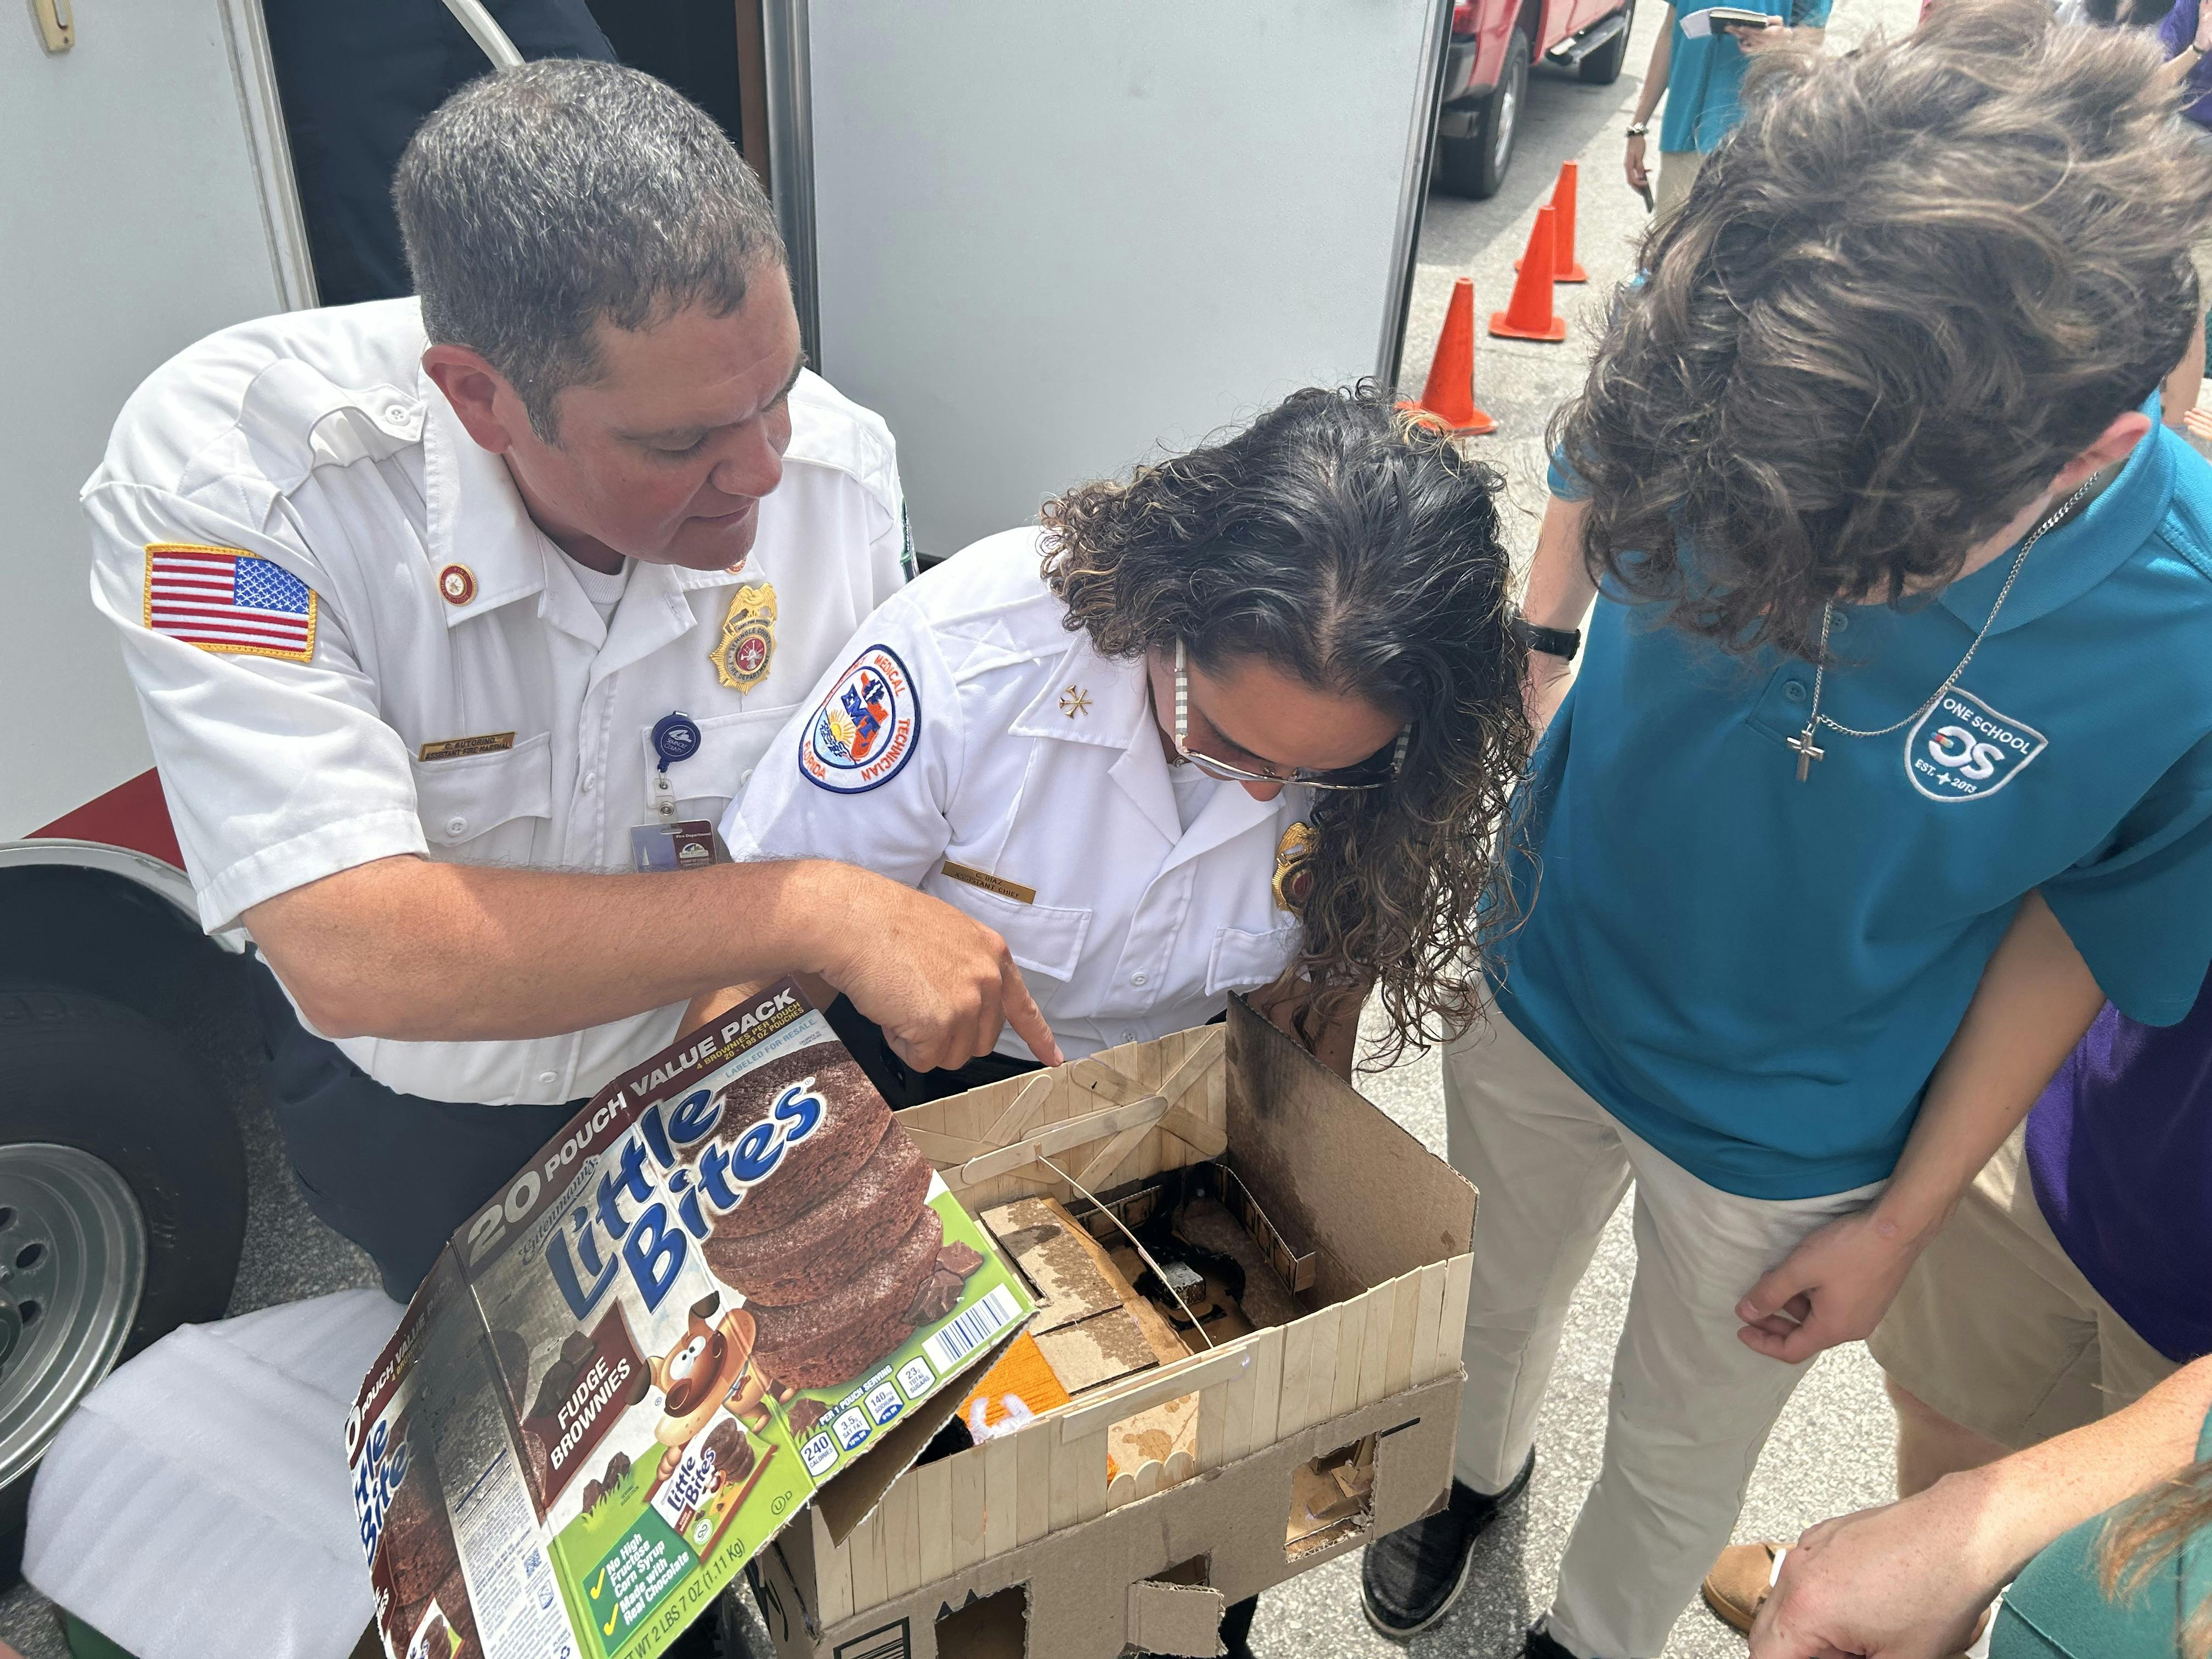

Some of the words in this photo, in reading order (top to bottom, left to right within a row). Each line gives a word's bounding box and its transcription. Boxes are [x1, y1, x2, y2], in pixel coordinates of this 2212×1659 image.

[731, 628, 755, 651] SEMINOLE
[757, 628, 771, 644] COUNTY
[728, 662, 739, 676] FIRE
[738, 657, 769, 681] DEPARTMENT
[874, 654, 906, 697] MEDICAL
[841, 684, 881, 739] EMT
[1943, 699, 1974, 721] ONE
[1972, 716, 2030, 754] SCHOOL
[426, 749, 462, 760] ASSISTANT
[479, 742, 510, 752] MARSHAL
[454, 737, 495, 748] AUTORINO
[803, 740, 826, 780] FLORIDA
[862, 718, 911, 782] TECHNICIAN
[1915, 759, 1936, 776] EST.
[955, 873, 995, 890] ASSISTANT
[998, 888, 1020, 898] CHIEF
[985, 876, 1003, 886] DIAZ
[704, 1032, 751, 1066] BROWNIES
[752, 1020, 770, 1036] PER
[771, 1001, 801, 1024] POUCH
[724, 1051, 735, 1061] 20
[741, 1036, 757, 1051] 1.95
[758, 1029, 769, 1040] OZ
[769, 1007, 804, 1034] POUCHES
[725, 1050, 764, 1079] LABELED
[765, 1039, 782, 1053] FOR
[782, 1018, 817, 1041] RESALE
[468, 1170, 541, 1267] 20
[544, 1091, 627, 1182] POUCH
[629, 1036, 717, 1097] VALUE
[720, 987, 797, 1043] PACK
[545, 1089, 723, 1321] Little
[622, 1086, 821, 1314] Bites
[345, 1405, 361, 1459] 0
[362, 1360, 394, 1420] POUCH
[395, 1311, 426, 1363] VALUE
[557, 1356, 609, 1430] FUDGE
[819, 1408, 835, 1426] PER
[836, 1404, 840, 1414] 1
[840, 1386, 865, 1410] POUCH
[863, 1364, 893, 1392] SERVING
[875, 1395, 895, 1414] SODIUM
[909, 1374, 925, 1386] TOTAL
[910, 1376, 931, 1393] SUGARS
[550, 1358, 631, 1471] BROWNIES
[843, 1429, 853, 1439] SAT
[854, 1420, 864, 1432] FAT
[354, 1420, 390, 1505] ttle
[804, 1436, 829, 1462] 240
[809, 1447, 833, 1469] CALORIES
[360, 1441, 410, 1567] Bite
[667, 1457, 696, 1511] Little
[685, 1451, 715, 1506] Bites
[606, 1557, 620, 1576] No
[620, 1533, 642, 1560] High
[610, 1540, 651, 1587] Fructose
[614, 1571, 638, 1599] Corn
[639, 1541, 665, 1573] Syrup
[619, 1582, 646, 1613] Made
[646, 1558, 668, 1584] with
[623, 1600, 646, 1626] Real
[645, 1551, 689, 1602] Chocolate
[634, 1633, 651, 1658] WT
[652, 1626, 661, 1642] 2
[659, 1605, 680, 1634] LBS
[679, 1595, 687, 1612] 7
[688, 1579, 704, 1602] OZ
[703, 1557, 727, 1590] (1.11
[727, 1538, 746, 1562] Kg)
